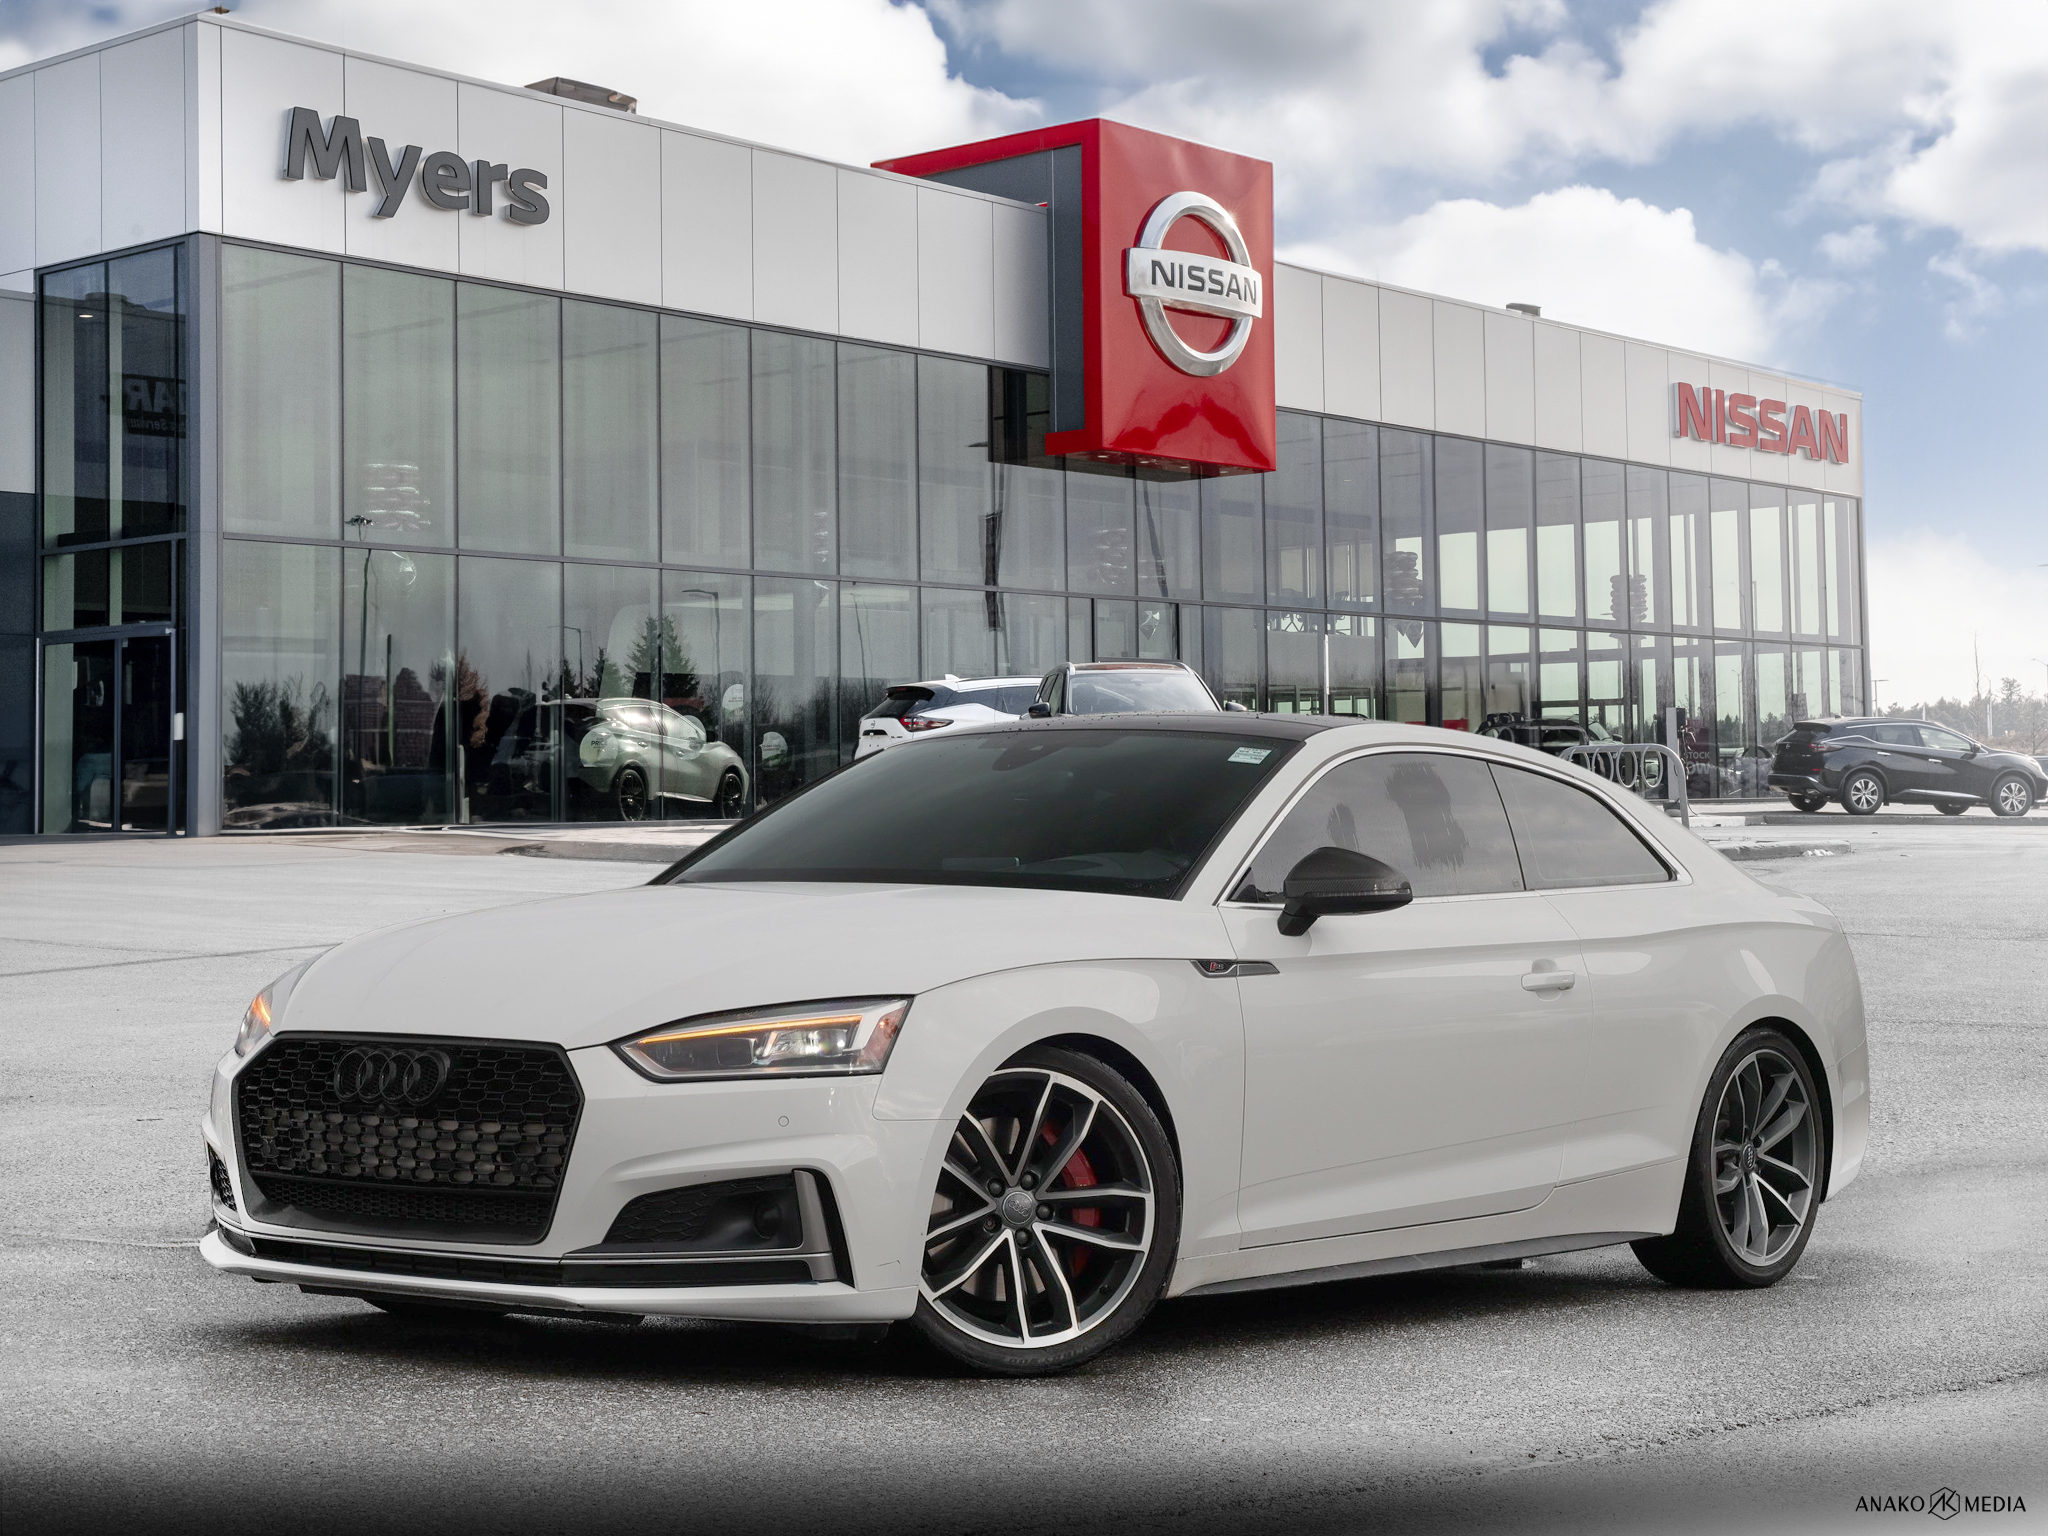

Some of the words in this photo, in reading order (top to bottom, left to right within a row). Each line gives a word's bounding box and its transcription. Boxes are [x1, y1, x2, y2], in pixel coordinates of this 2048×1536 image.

[284, 106, 550, 225] Myers
[1151, 259, 1257, 305] NISSAN
[1674, 382, 1849, 464] NISSAN
